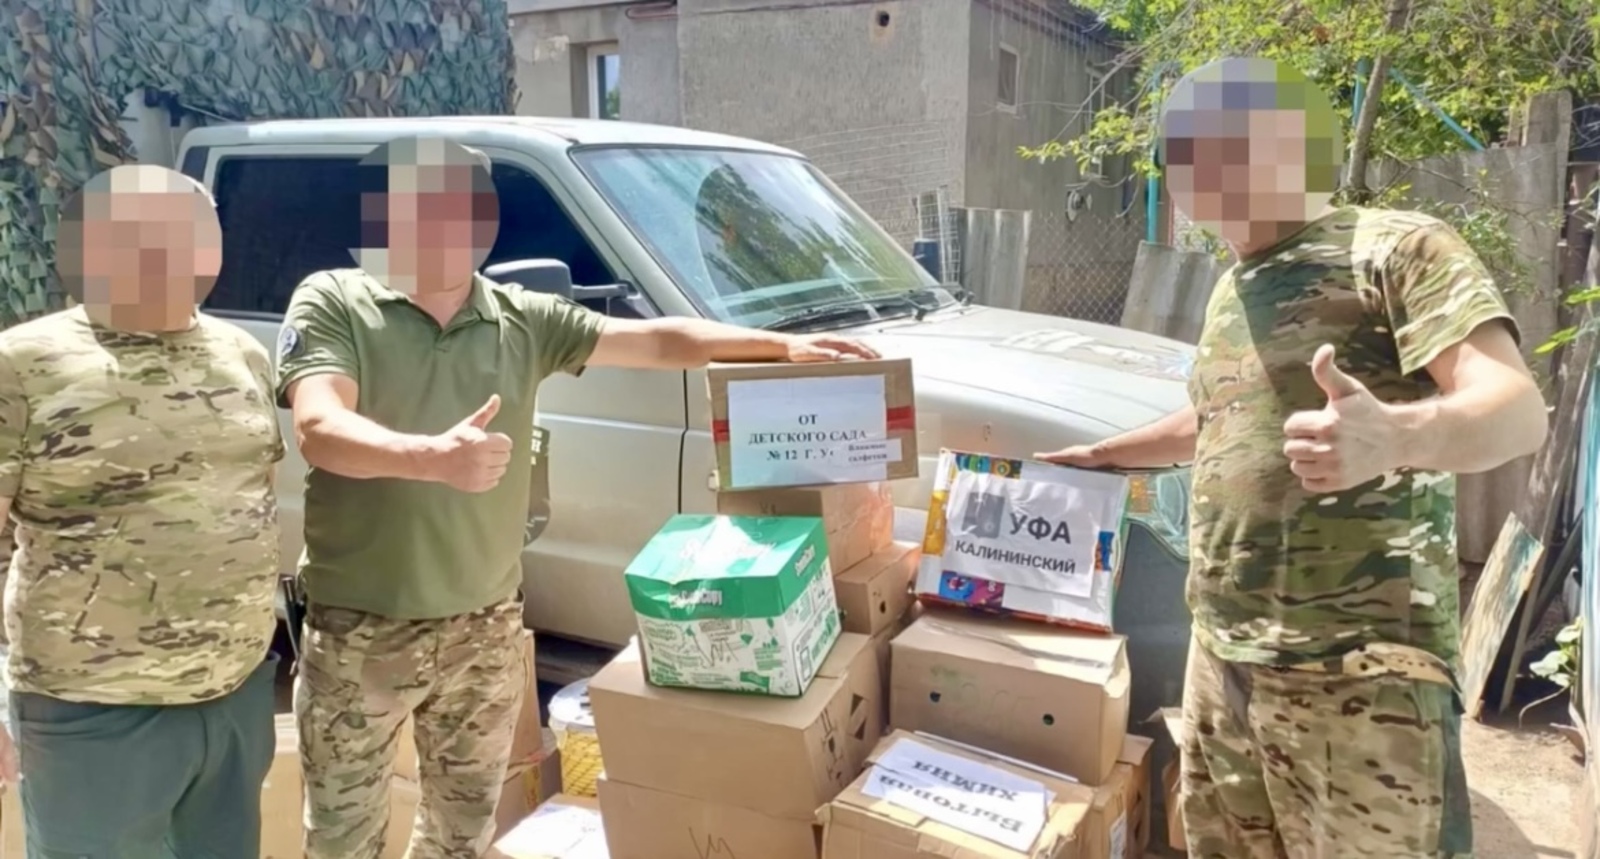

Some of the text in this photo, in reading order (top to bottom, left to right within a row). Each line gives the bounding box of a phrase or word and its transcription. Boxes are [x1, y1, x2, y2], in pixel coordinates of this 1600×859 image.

[798, 414, 818, 425] ОТ
[749, 430, 867, 445] ДЕТСКОГО САДА
[767, 449, 780, 460] №
[785, 449, 797, 460] 12
[1009, 511, 1072, 545] УФА
[955, 540, 1076, 574] КАЛИНИНСКИЙ
[879, 774, 1025, 834] Бытовая
